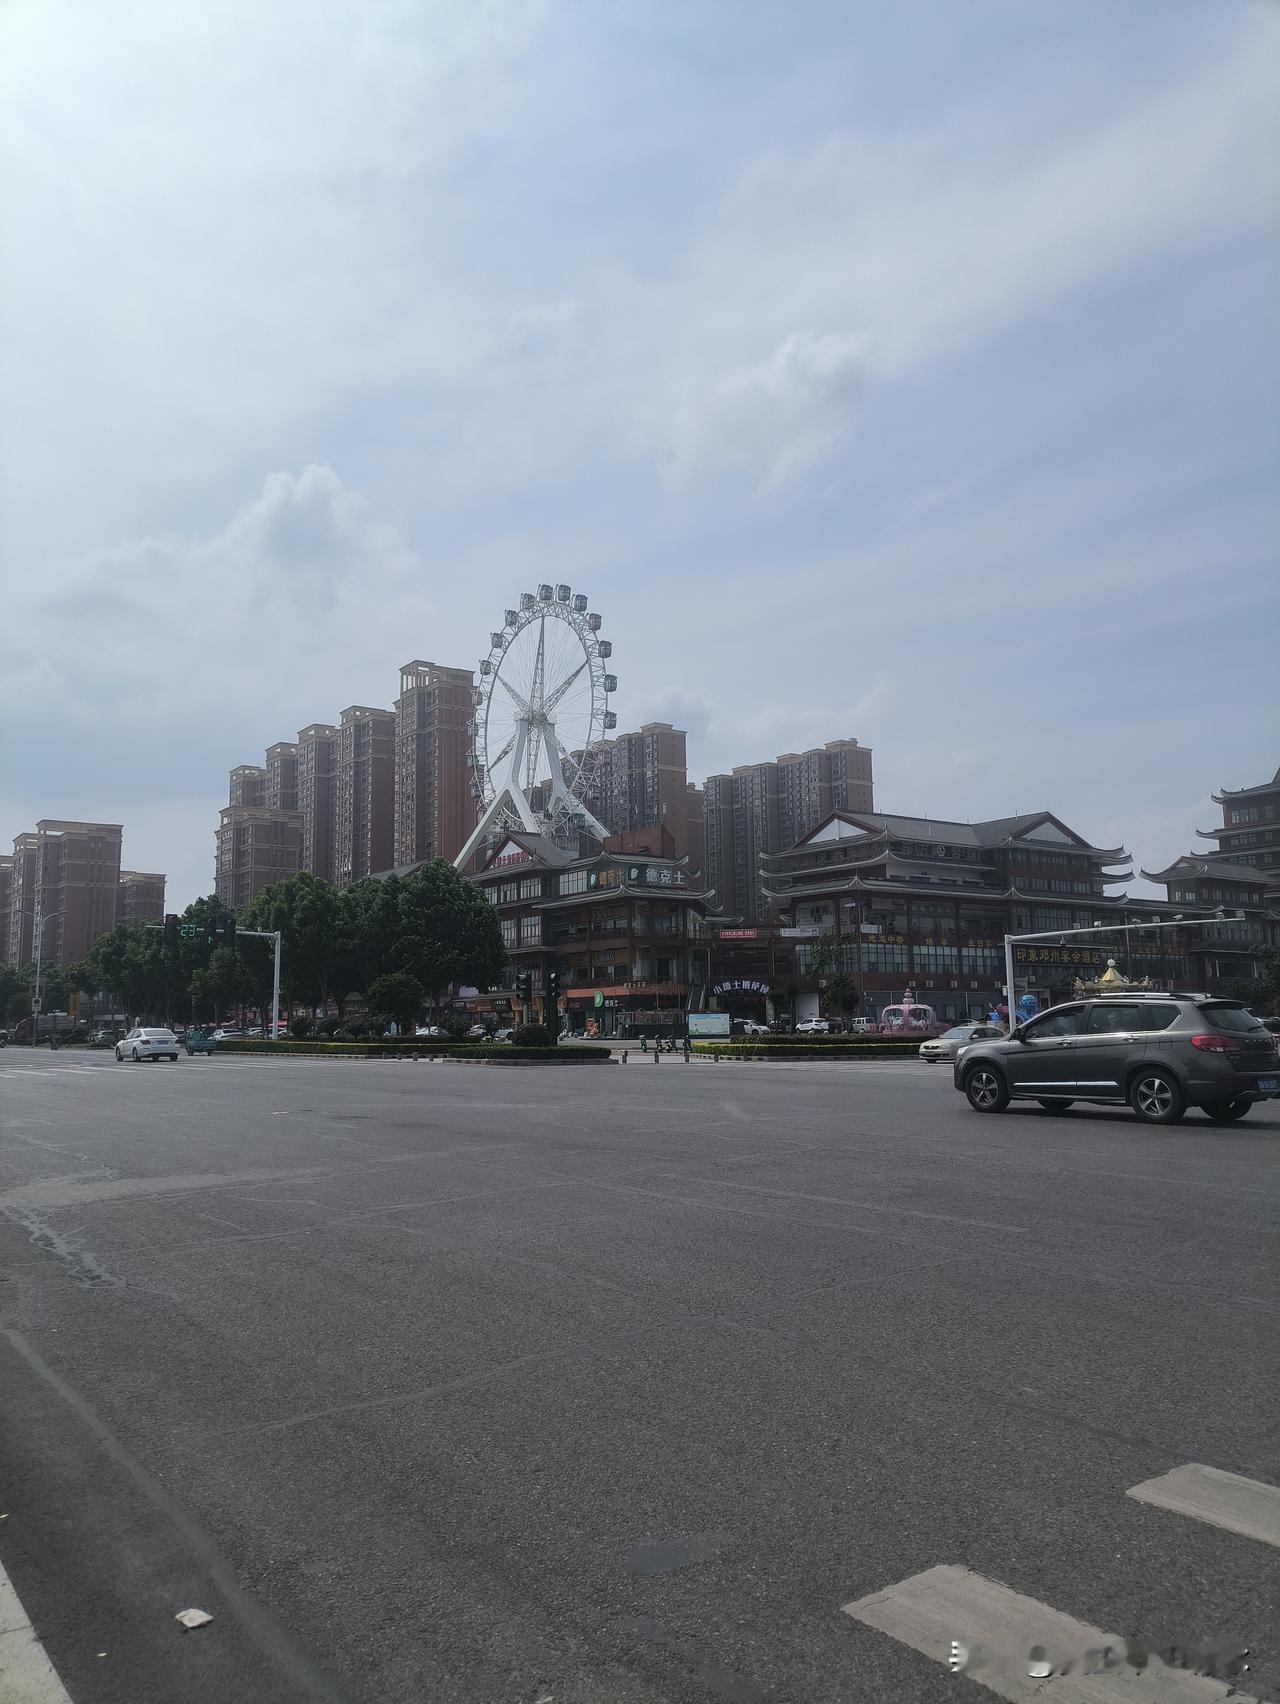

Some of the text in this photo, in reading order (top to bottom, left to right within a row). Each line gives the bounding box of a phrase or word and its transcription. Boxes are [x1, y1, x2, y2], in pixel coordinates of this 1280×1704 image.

[645, 867, 685, 885] 德克士
[180, 924, 196, 937] 23
[1015, 947, 1101, 965] 印象邓州宴会酒店
